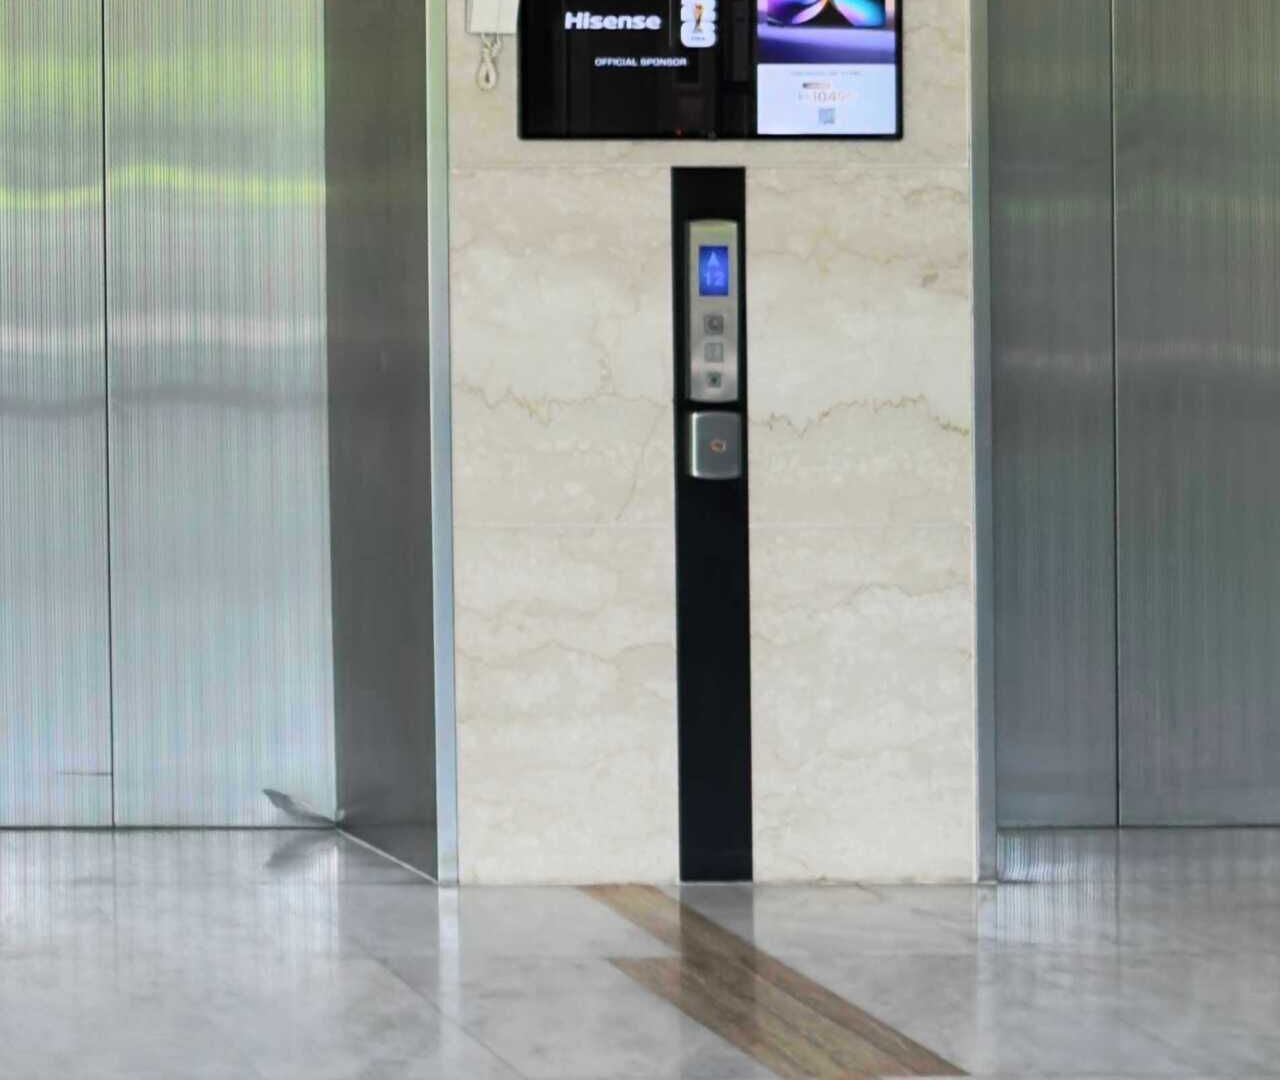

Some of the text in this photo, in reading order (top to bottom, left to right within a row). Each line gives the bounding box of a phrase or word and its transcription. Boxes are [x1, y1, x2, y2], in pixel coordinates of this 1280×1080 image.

[564, 11, 662, 30] Hisense
[594, 56, 687, 67] OFFICIAL SPONSOR
